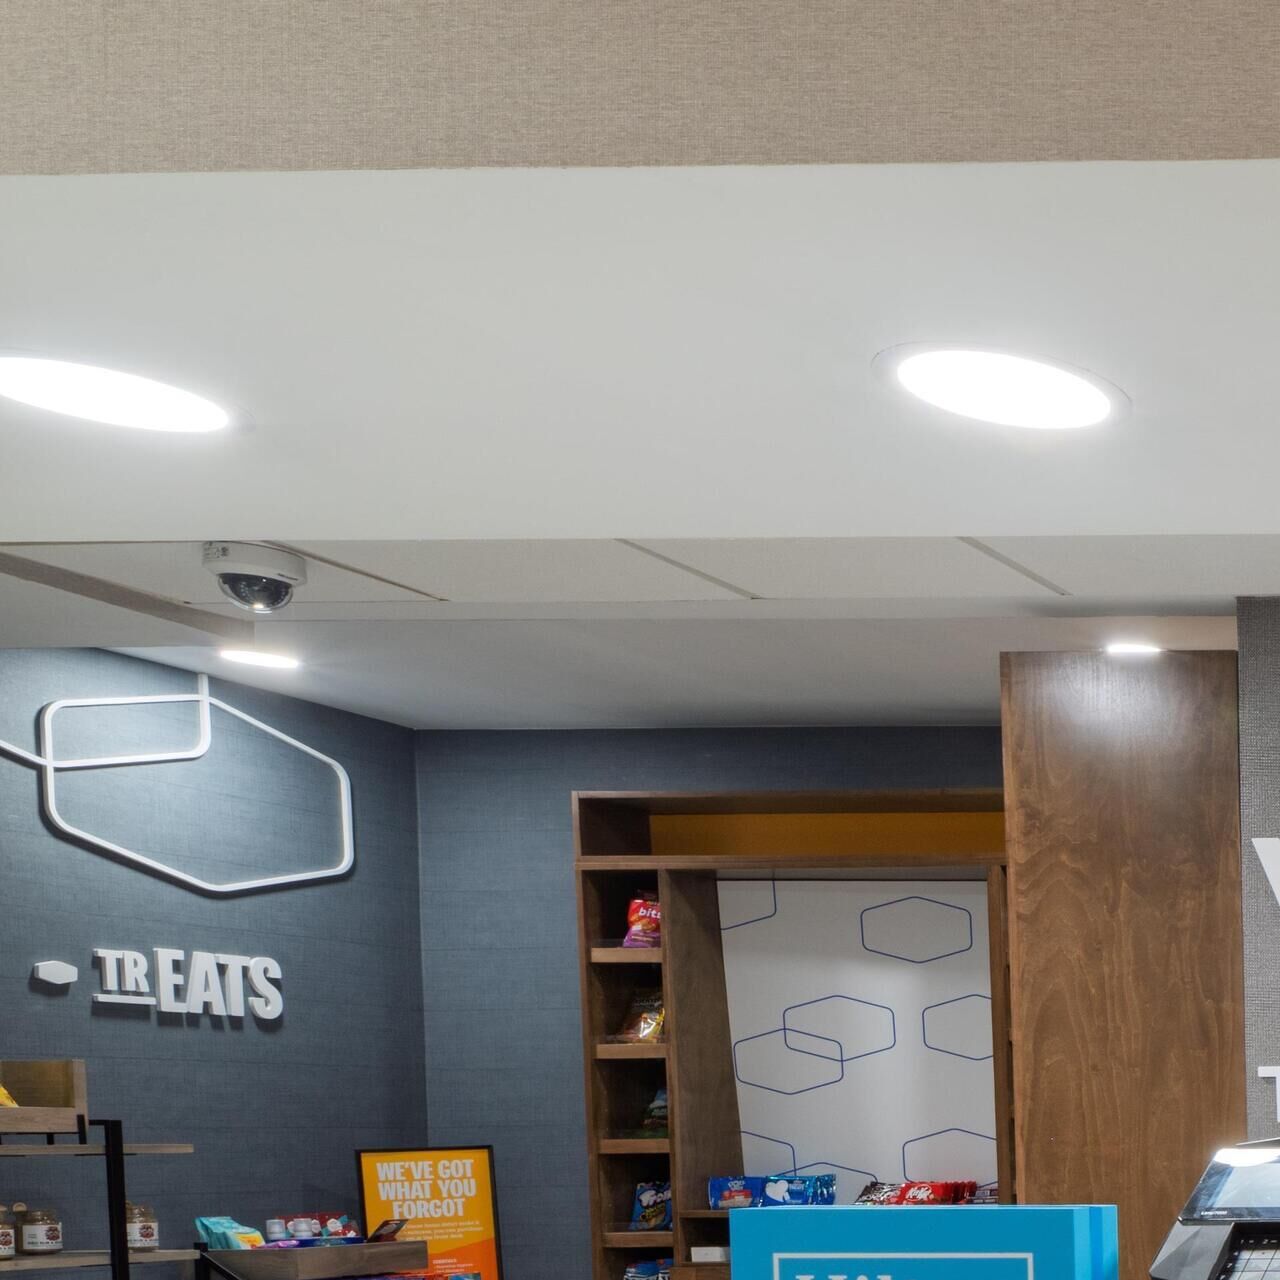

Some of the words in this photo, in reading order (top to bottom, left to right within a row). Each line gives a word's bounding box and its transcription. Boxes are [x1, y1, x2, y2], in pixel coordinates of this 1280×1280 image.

[93, 947, 284, 1020] TREATS
[376, 1161, 434, 1181] WE'VE
[438, 1159, 475, 1179] GOT
[378, 1180, 433, 1200] WHAT
[437, 1179, 476, 1197] YOU
[392, 1198, 466, 1219] FORGOT
